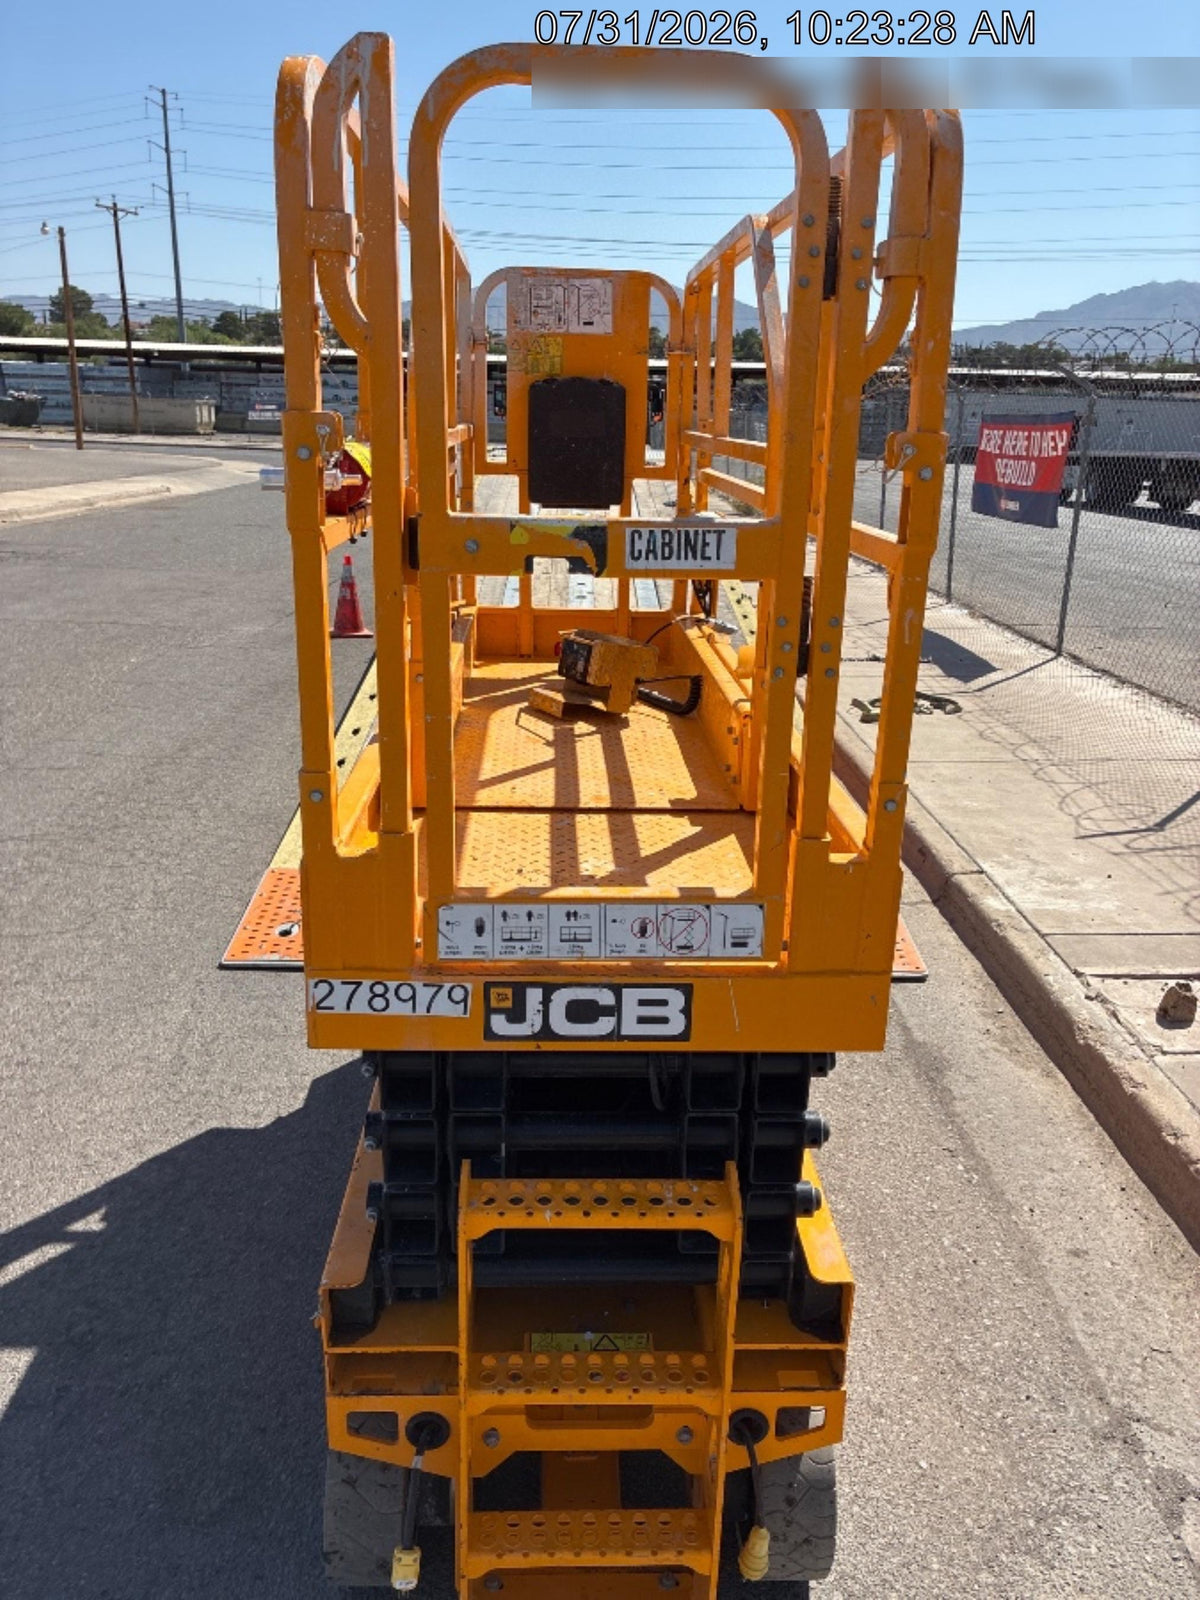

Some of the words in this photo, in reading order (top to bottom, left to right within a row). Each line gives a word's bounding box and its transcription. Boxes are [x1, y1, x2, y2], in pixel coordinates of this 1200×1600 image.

[629, 529, 726, 562] CABINET
[312, 979, 470, 1016] 278979
[490, 986, 688, 1037] JCB
